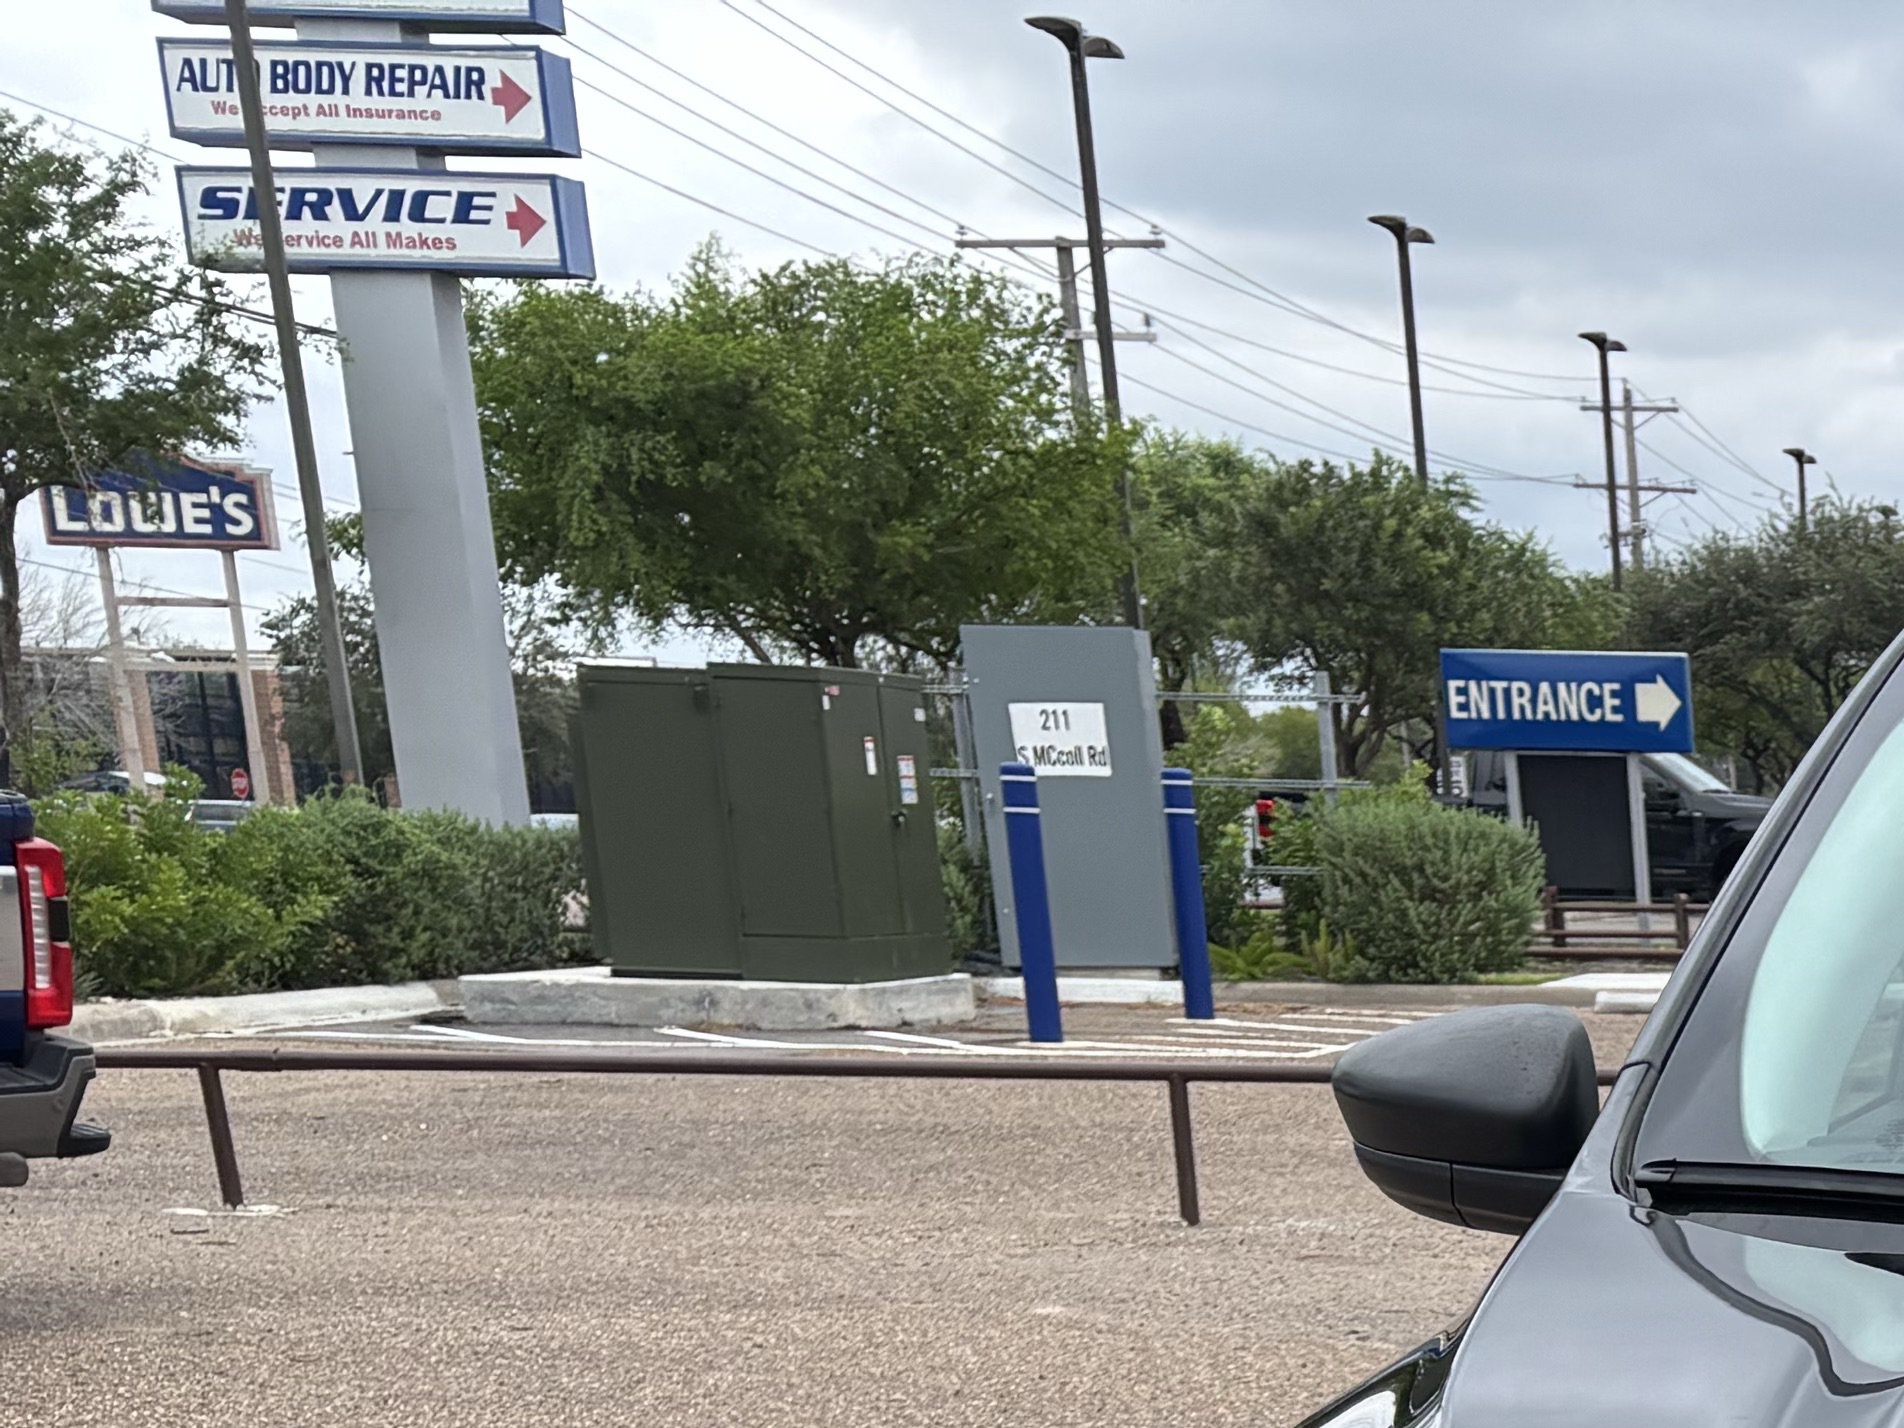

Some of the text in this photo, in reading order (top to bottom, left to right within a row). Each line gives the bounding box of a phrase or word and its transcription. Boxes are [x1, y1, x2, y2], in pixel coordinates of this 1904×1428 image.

[176, 57, 486, 101] AUT BODY REPAIR
[211, 100, 238, 116] We
[315, 103, 341, 119] All
[345, 106, 443, 122] Insurance
[232, 228, 458, 252] We ervice All Makes
[51, 484, 255, 537] LOWE'S
[1448, 679, 1625, 722] ENTRANCE
[1039, 709, 1071, 731] 211
[1017, 745, 1030, 765] S
[1087, 745, 1107, 767] Rd
